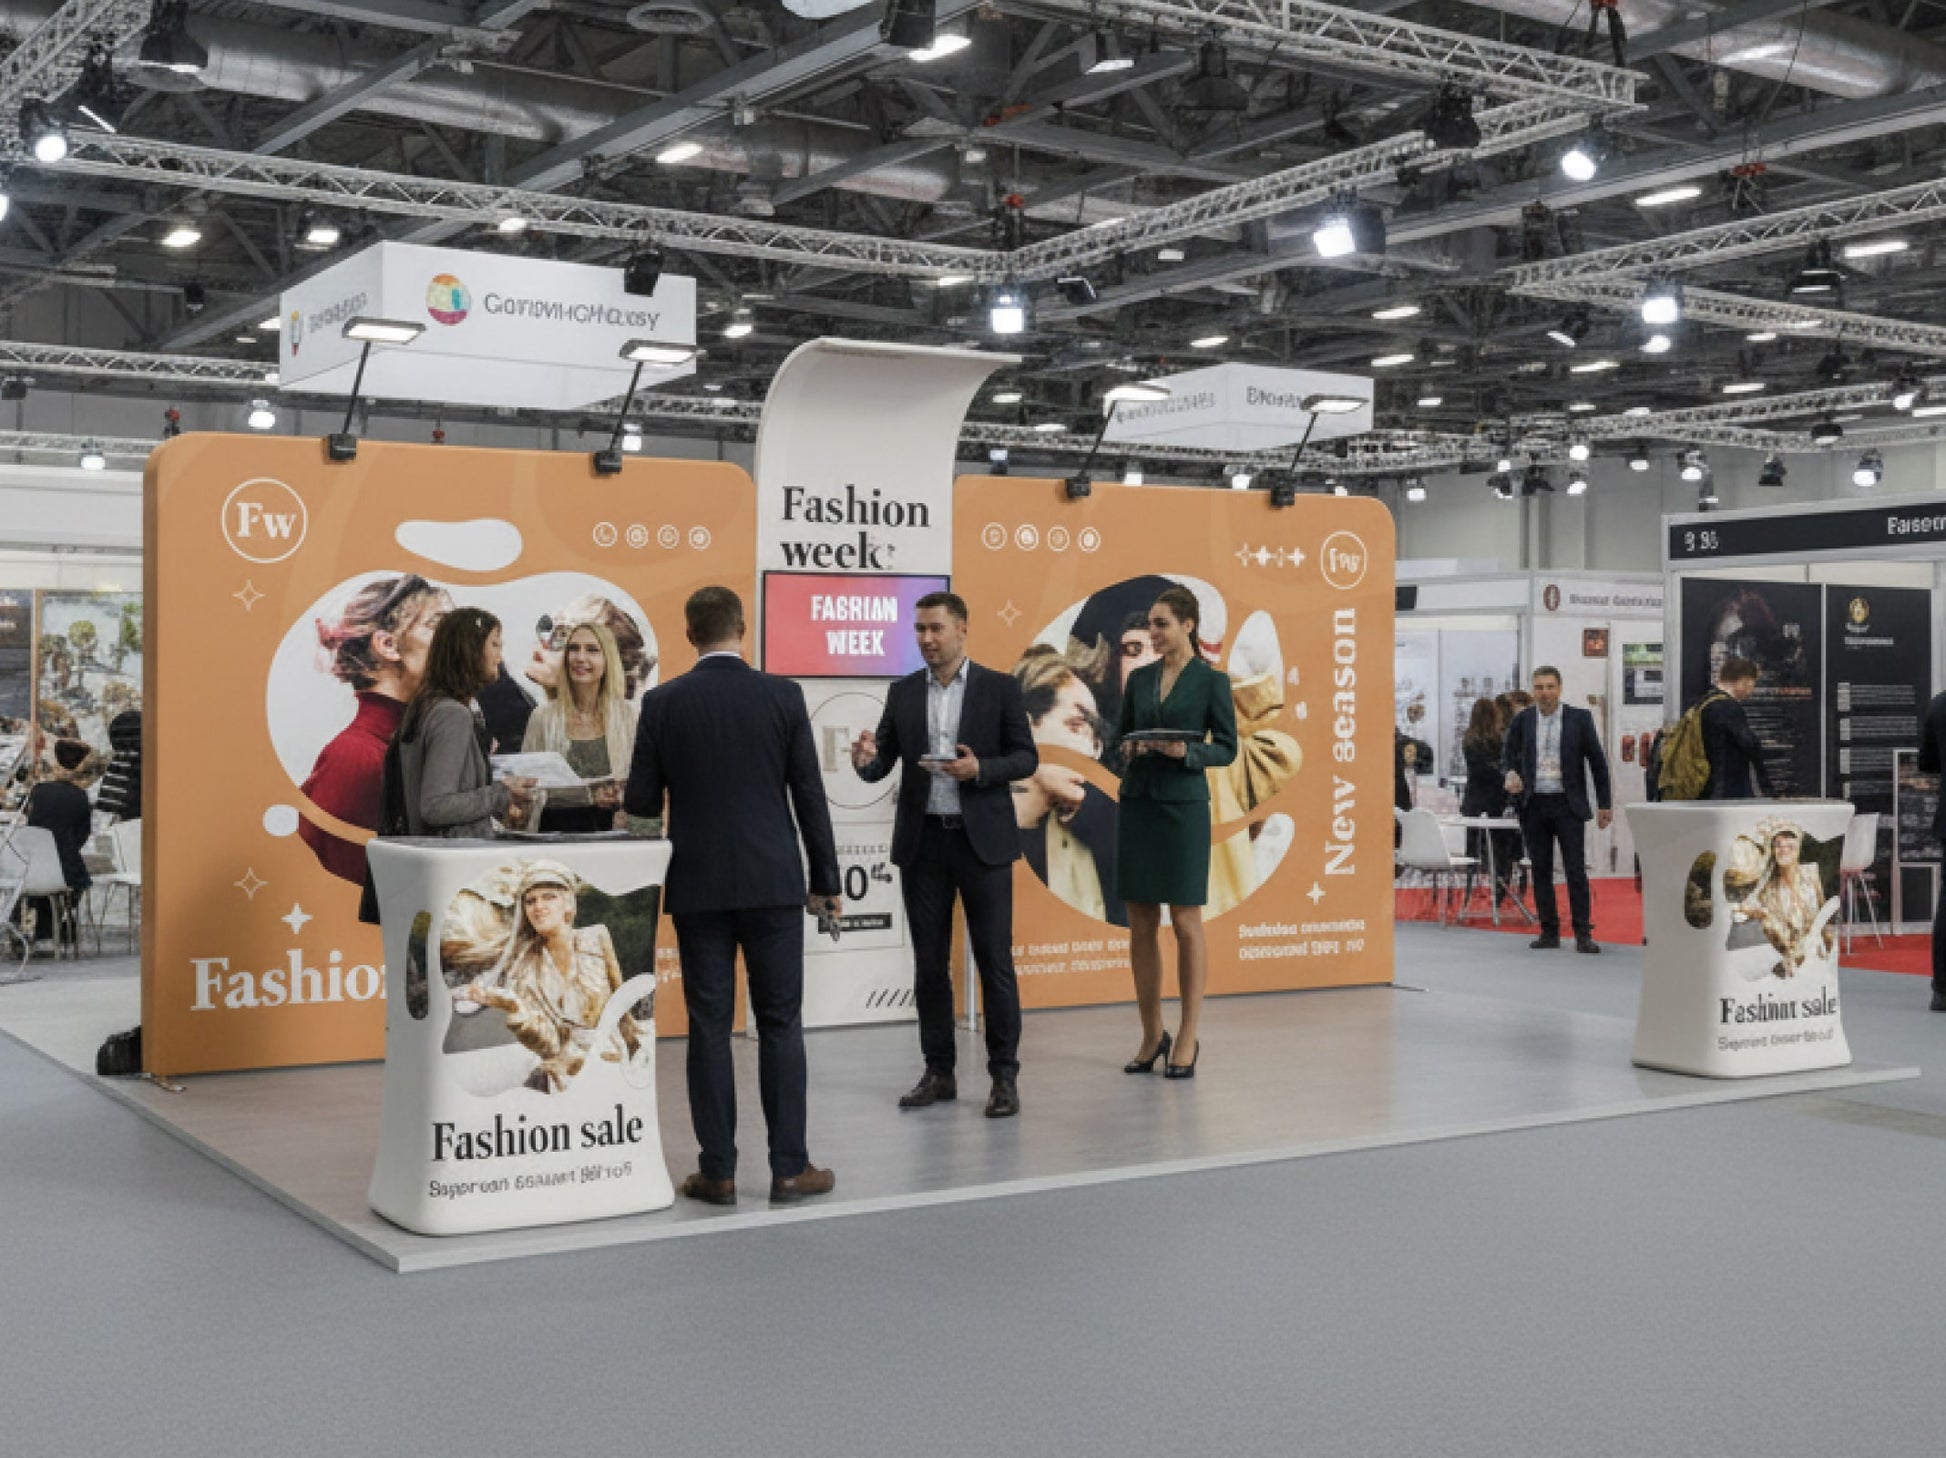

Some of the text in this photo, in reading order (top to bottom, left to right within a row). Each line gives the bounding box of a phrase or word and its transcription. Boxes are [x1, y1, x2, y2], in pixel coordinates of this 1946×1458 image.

[236, 502, 297, 539] Fw
[782, 484, 931, 528] Fashion
[826, 629, 885, 657] WEEK
[1324, 775, 1356, 876] New
[432, 1103, 643, 1162] Fashion sale
